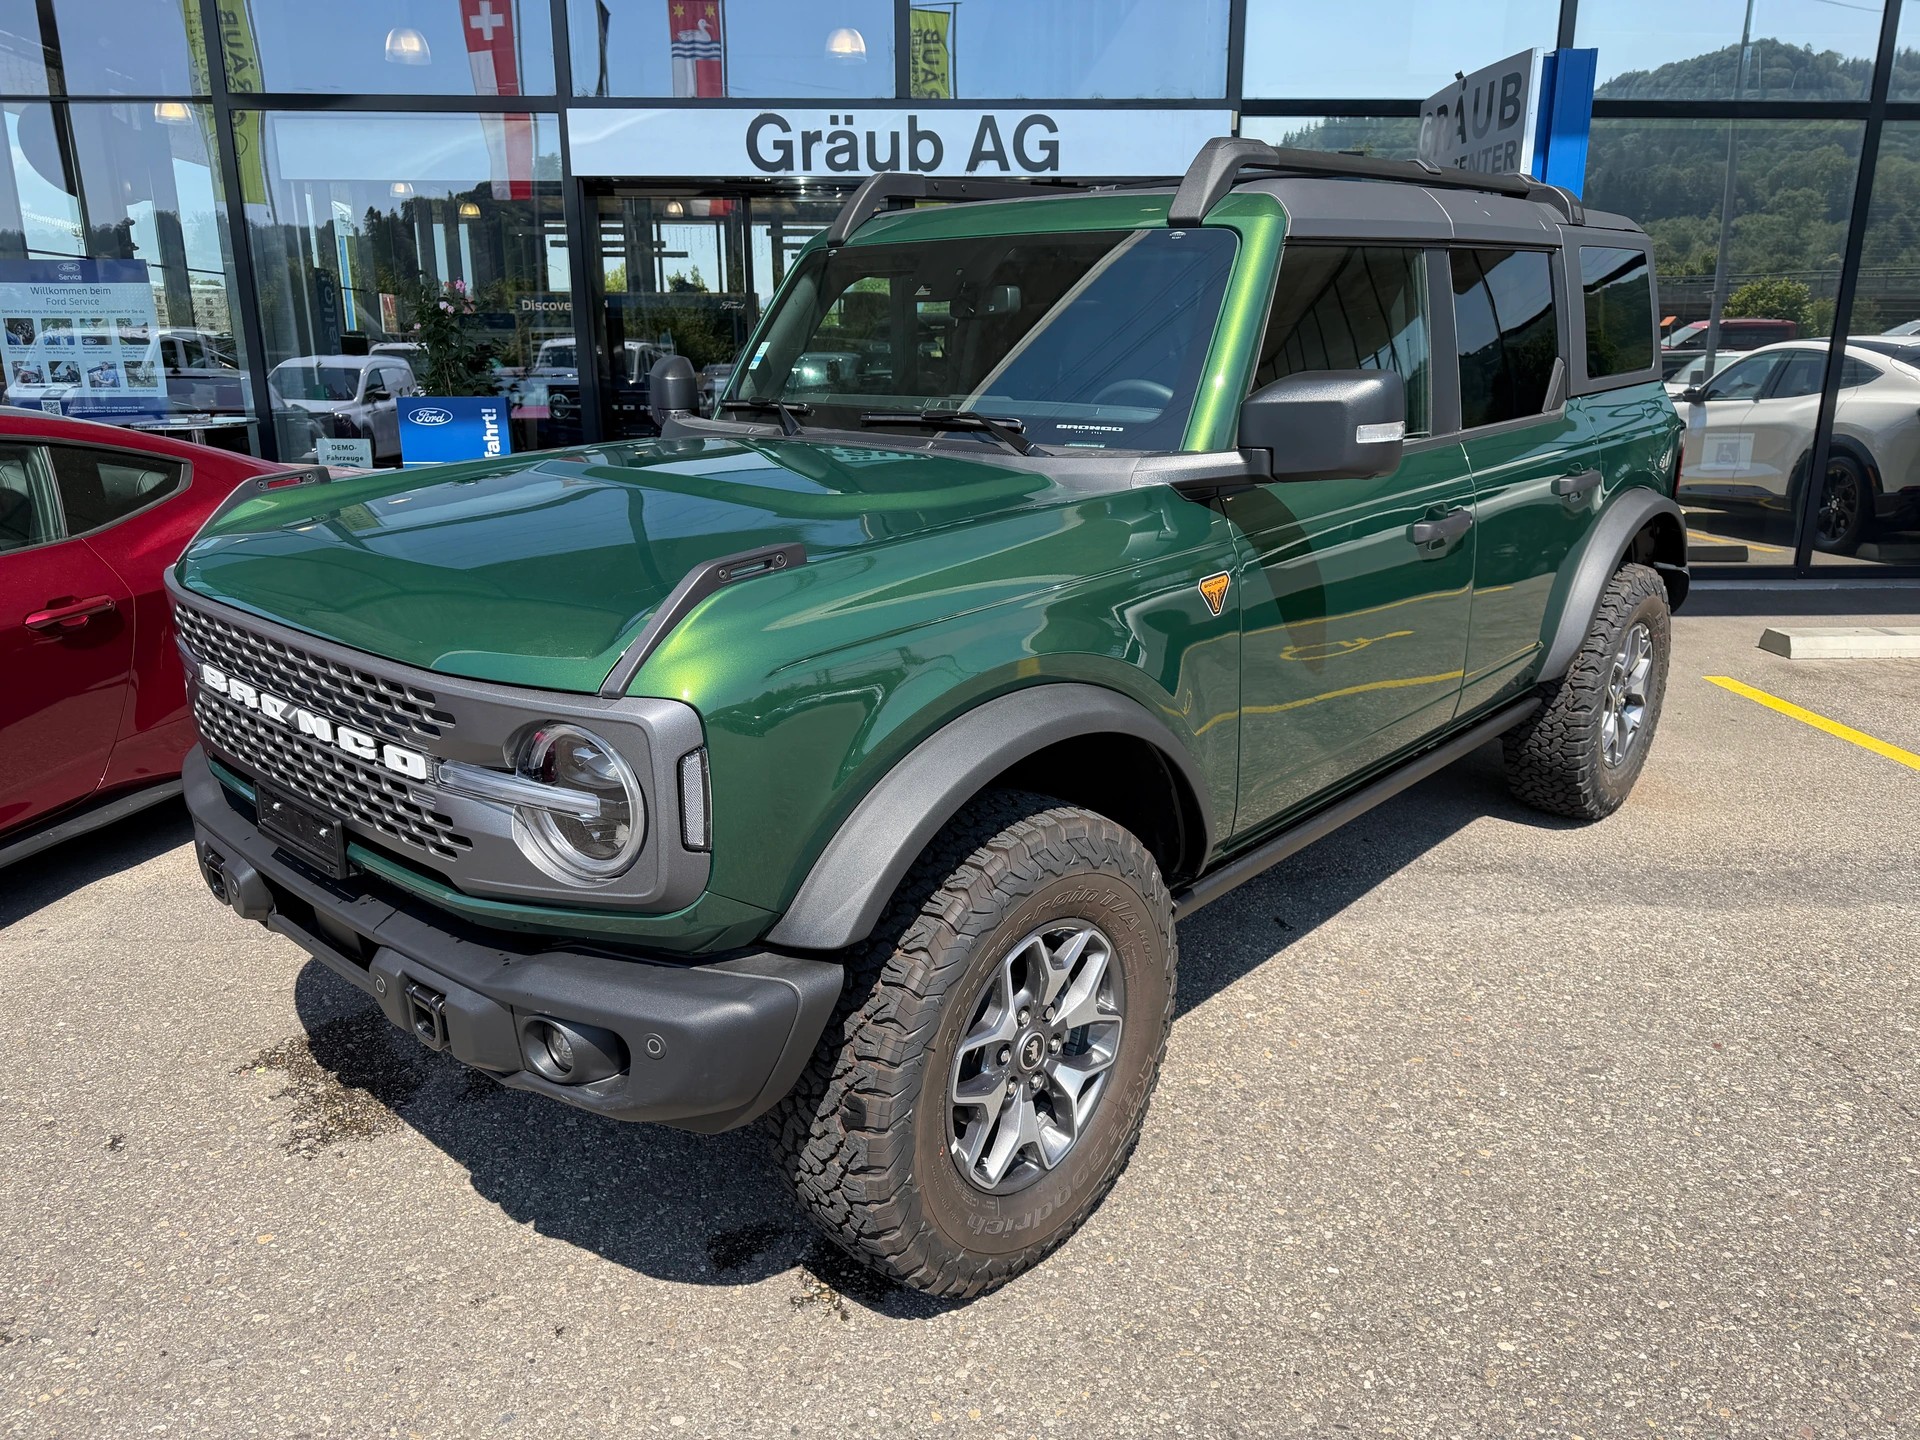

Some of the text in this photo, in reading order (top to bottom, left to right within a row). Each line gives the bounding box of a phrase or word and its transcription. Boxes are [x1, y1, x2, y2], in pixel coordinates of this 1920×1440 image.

[745, 112, 1060, 173] Gräub AG
[30, 286, 112, 295] Willkommen beim
[45, 297, 100, 306] Ford Service
[521, 299, 573, 311] Discove
[1056, 424, 1124, 432] BRONCO
[326, 454, 364, 462] Fahrzeuge
[202, 663, 427, 780] BRONCO
